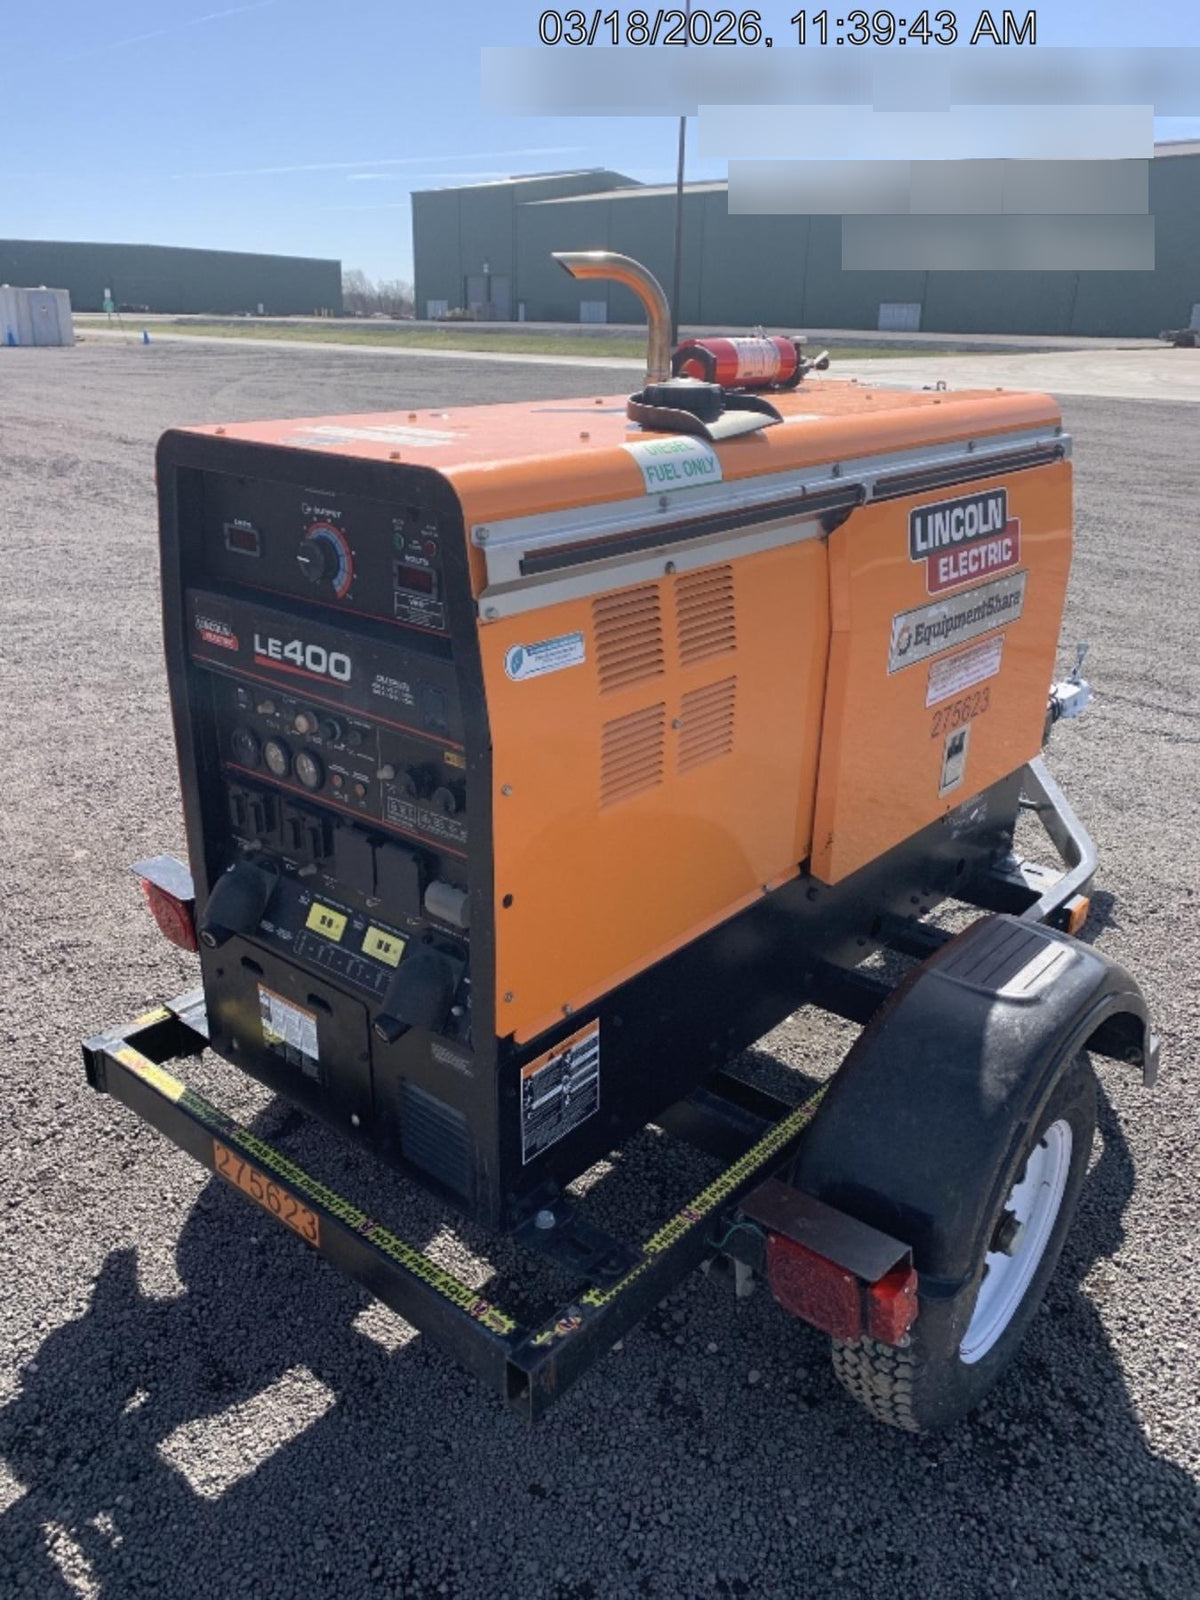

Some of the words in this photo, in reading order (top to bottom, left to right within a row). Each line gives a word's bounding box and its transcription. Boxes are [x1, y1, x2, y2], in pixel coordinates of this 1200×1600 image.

[645, 463, 681, 483] FUEL
[682, 456, 715, 477] ONLY
[914, 497, 1003, 553] LINCOLN
[938, 537, 1013, 583] ELECTRIC
[912, 587, 1021, 647] EquipmentShare
[253, 633, 352, 683] LE400
[930, 686, 991, 739] 275623
[216, 1144, 317, 1241] 275623
[300, 1178, 346, 1212] DEBOUT
[655, 1221, 685, 1247] HERE
[371, 1230, 392, 1246] NO
[391, 1244, 408, 1257] SE
[406, 1256, 441, 1281] PARE
[438, 1279, 474, 1304] AQUI
